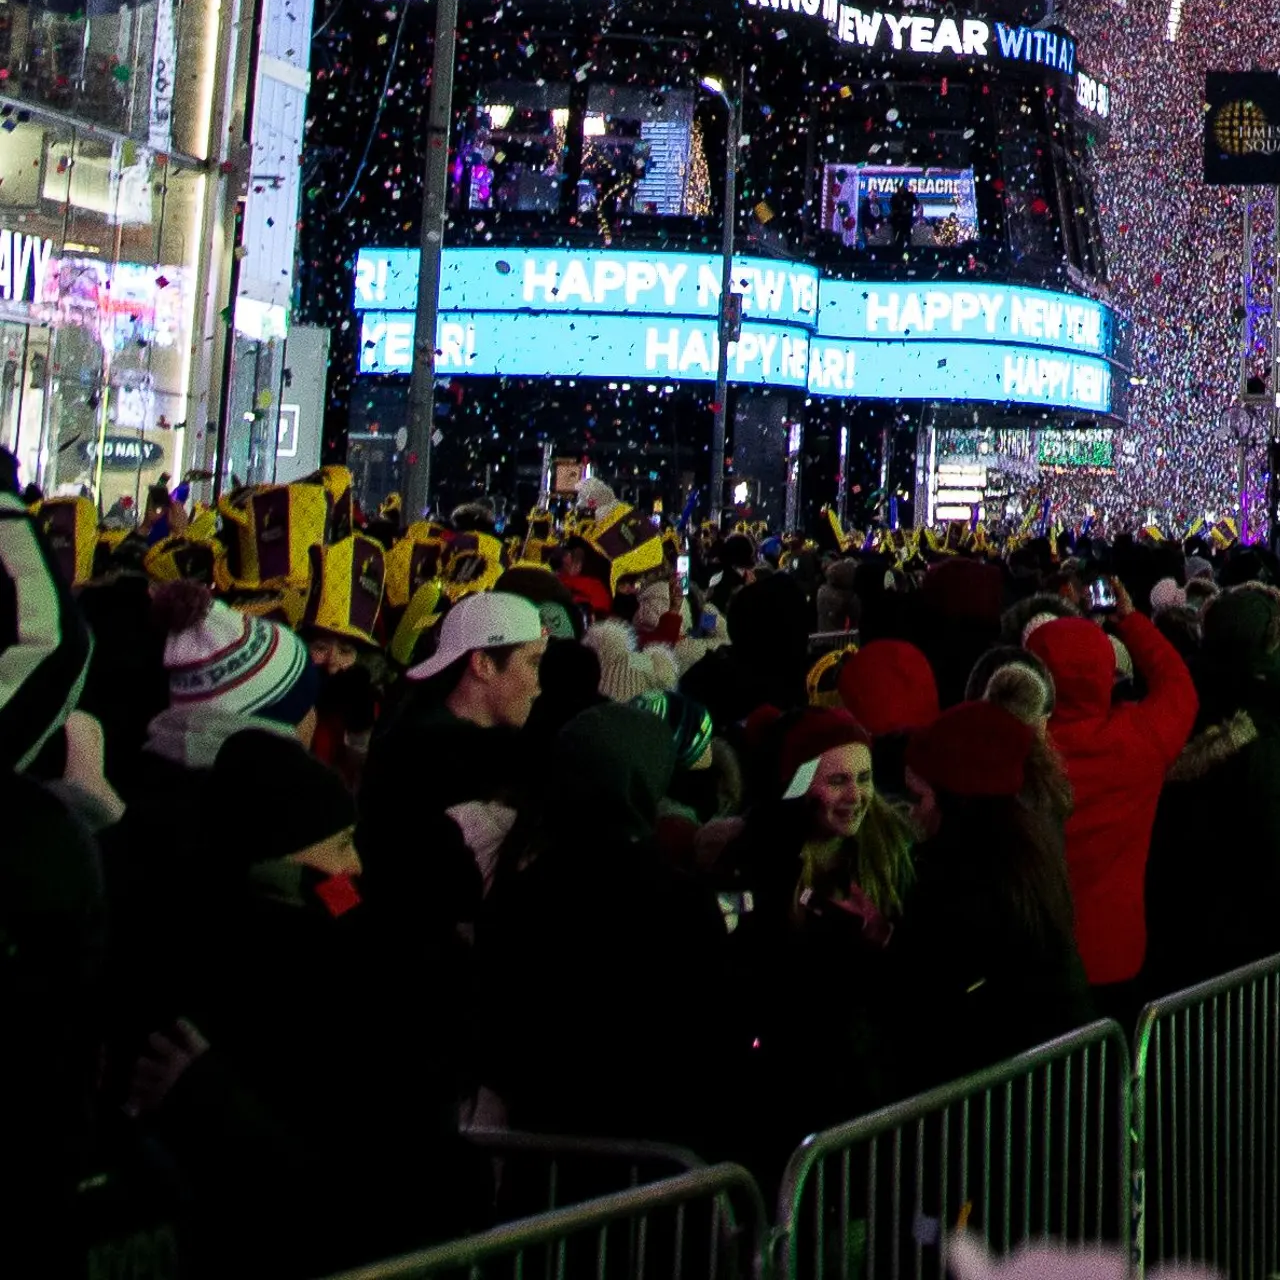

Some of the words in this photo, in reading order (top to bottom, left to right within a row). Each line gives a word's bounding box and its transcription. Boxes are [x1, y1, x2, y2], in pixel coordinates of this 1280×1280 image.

[884, 13, 990, 56] YEAR
[994, 22, 1057, 68] WITH
[521, 258, 688, 306] HAPPY
[697, 264, 786, 312] NEW
[865, 291, 1006, 334] HAPPY
[1010, 295, 1063, 341] NEW
[360, 321, 476, 369] YER!
[1003, 355, 1071, 400] HAPPY
[86, 441, 113, 460] OD
